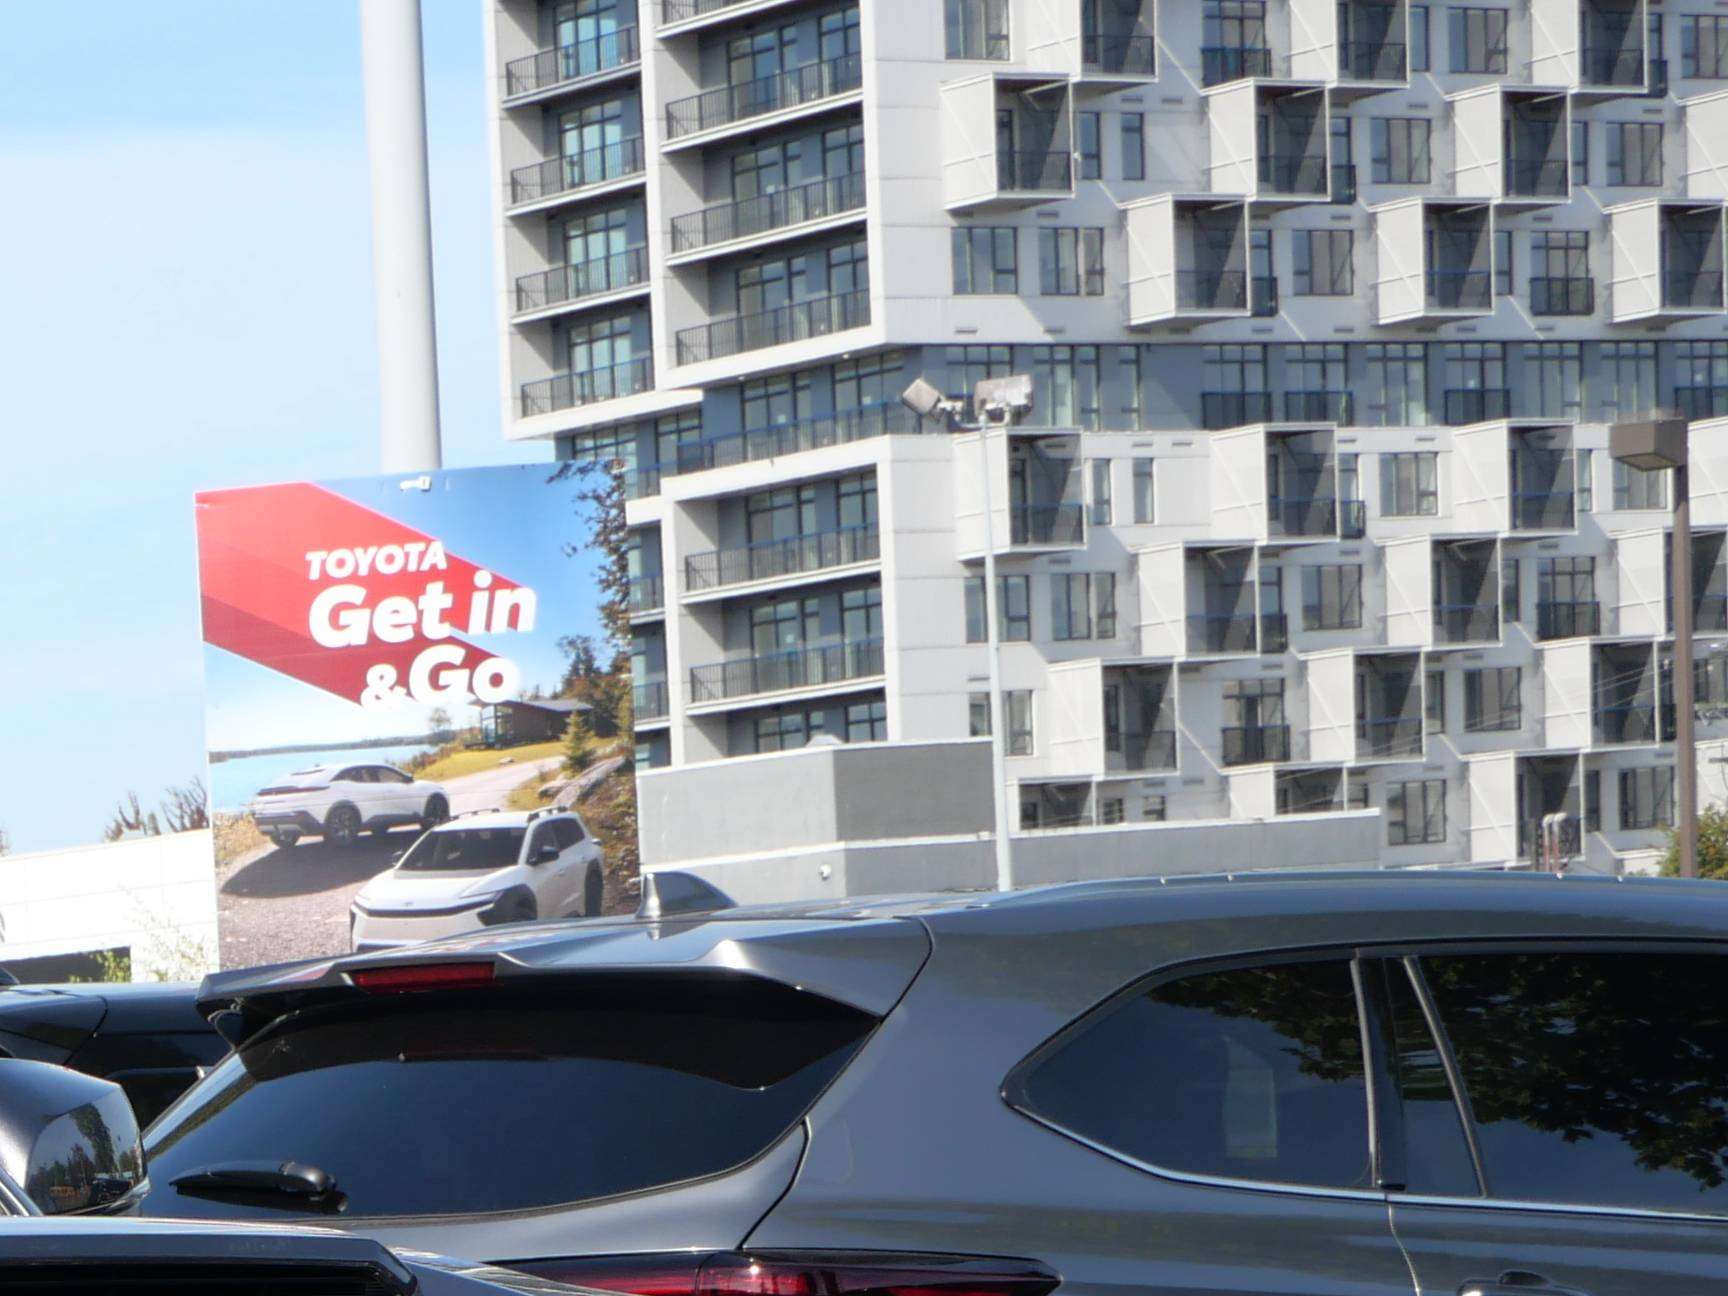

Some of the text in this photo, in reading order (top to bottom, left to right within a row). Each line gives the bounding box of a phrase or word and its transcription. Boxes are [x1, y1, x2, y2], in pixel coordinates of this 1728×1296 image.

[306, 541, 447, 580] TOYOTA
[309, 571, 537, 648] Get in
